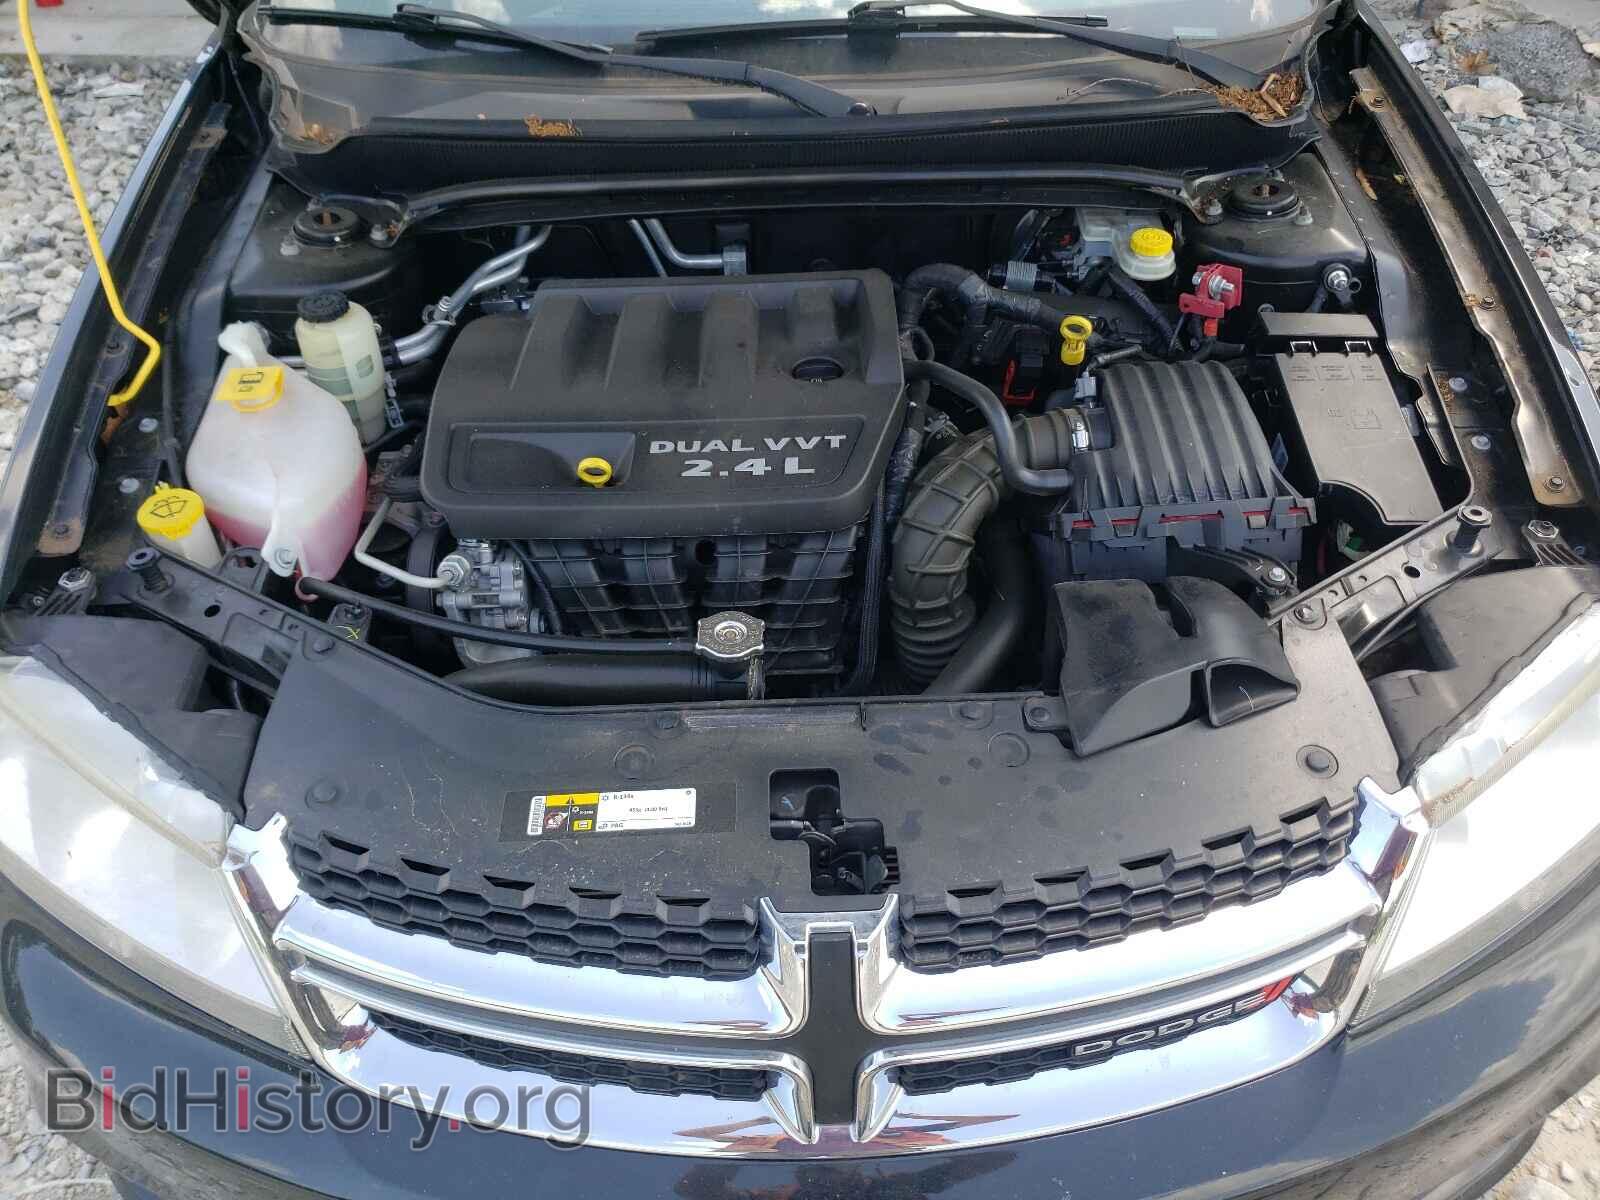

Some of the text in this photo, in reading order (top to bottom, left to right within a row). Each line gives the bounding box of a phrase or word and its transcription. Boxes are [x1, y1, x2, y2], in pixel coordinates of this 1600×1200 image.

[649, 434, 847, 454] DUAL VVT
[1074, 991, 1268, 1056] DODGE
